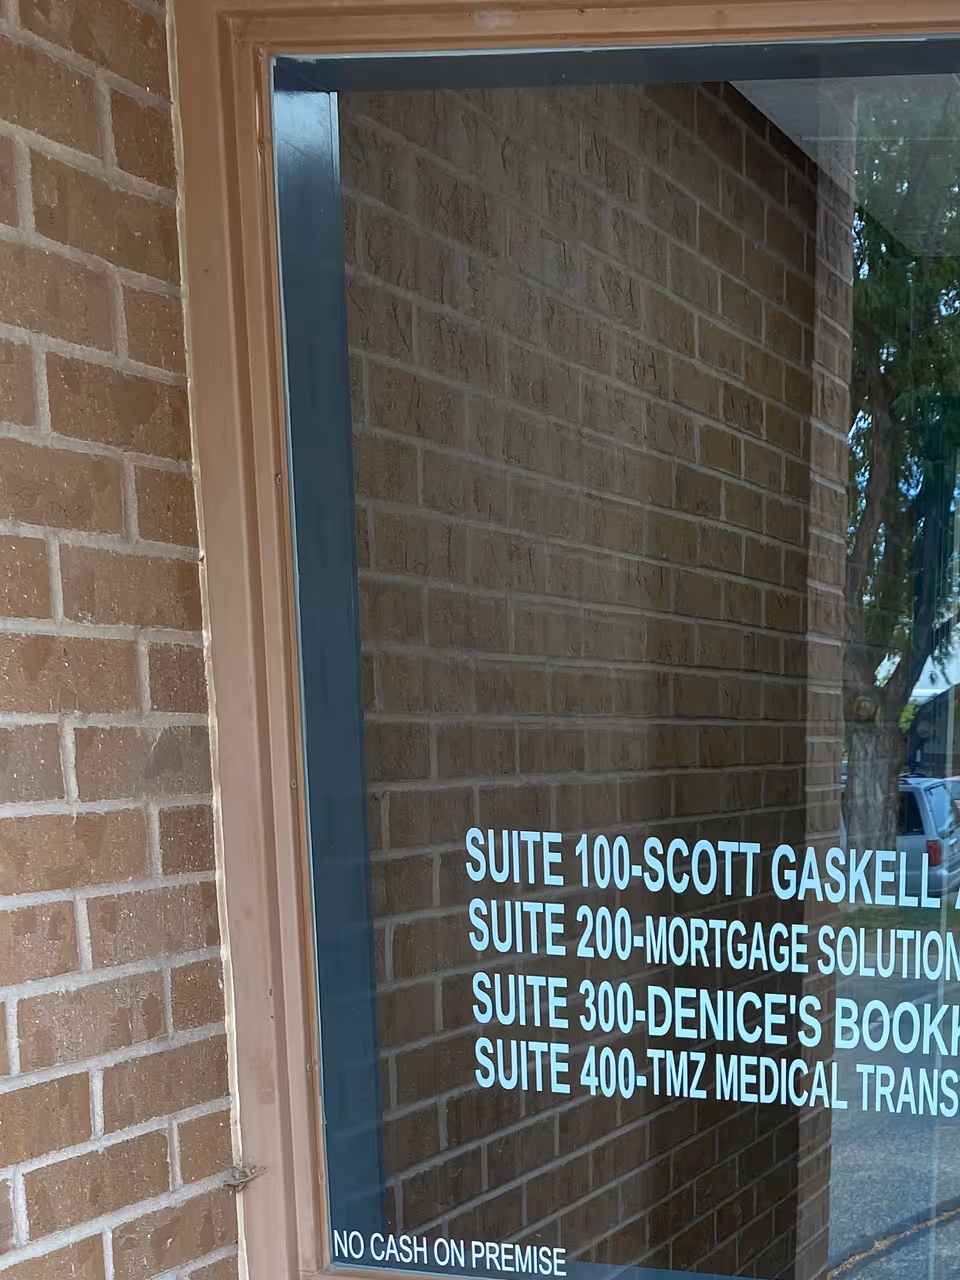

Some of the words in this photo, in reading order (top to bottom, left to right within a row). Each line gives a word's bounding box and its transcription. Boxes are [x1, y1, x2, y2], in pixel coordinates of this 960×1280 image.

[465, 827, 564, 886] SUITE
[575, 833, 761, 897] 100-SCOTT
[771, 844, 941, 909] GASKELL
[468, 898, 567, 956] SUITE
[576, 905, 809, 973] 200-MORTGAGE
[472, 971, 569, 1029] SUITE
[579, 979, 822, 1048] 300-DENICE'S
[474, 1037, 571, 1094] SUITE
[580, 1045, 707, 1100] 400-TMZ
[716, 1053, 848, 1110] MEDICAL
[333, 1229, 365, 1259] NO
[370, 1232, 428, 1264] CASH
[433, 1237, 465, 1267] ON
[471, 1240, 567, 1277] PREMISE
